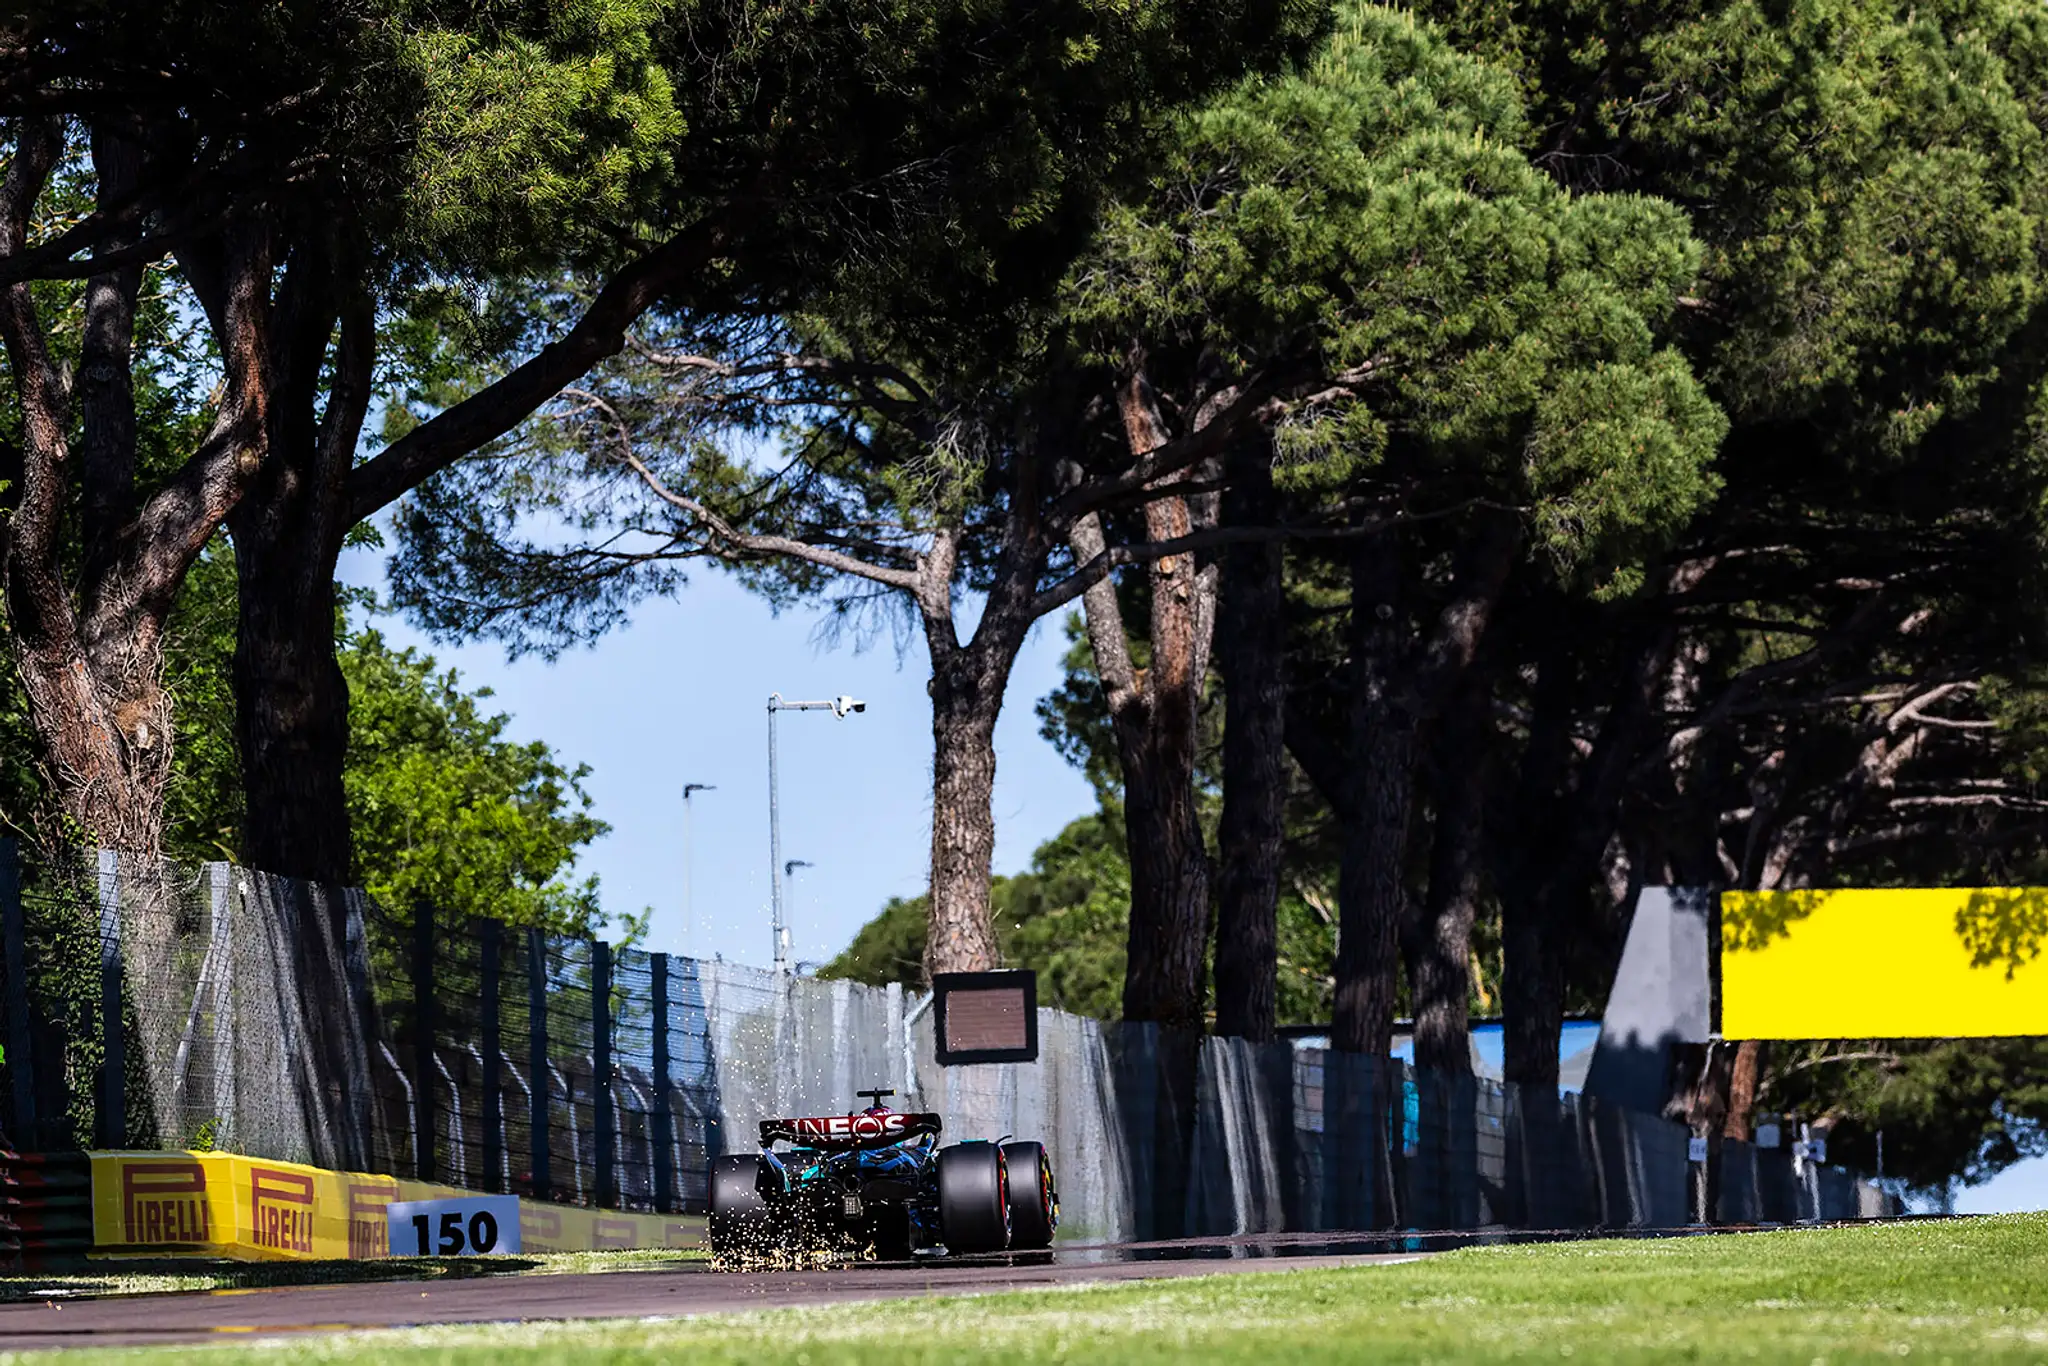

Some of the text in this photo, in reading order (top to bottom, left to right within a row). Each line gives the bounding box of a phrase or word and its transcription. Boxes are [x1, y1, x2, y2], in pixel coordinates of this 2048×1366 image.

[793, 1115, 905, 1141] INEOS
[123, 1164, 210, 1242] PIRELLI
[251, 1168, 314, 1252] PIRELLI
[349, 1185, 400, 1258] PIREL
[412, 1211, 497, 1255] 150
